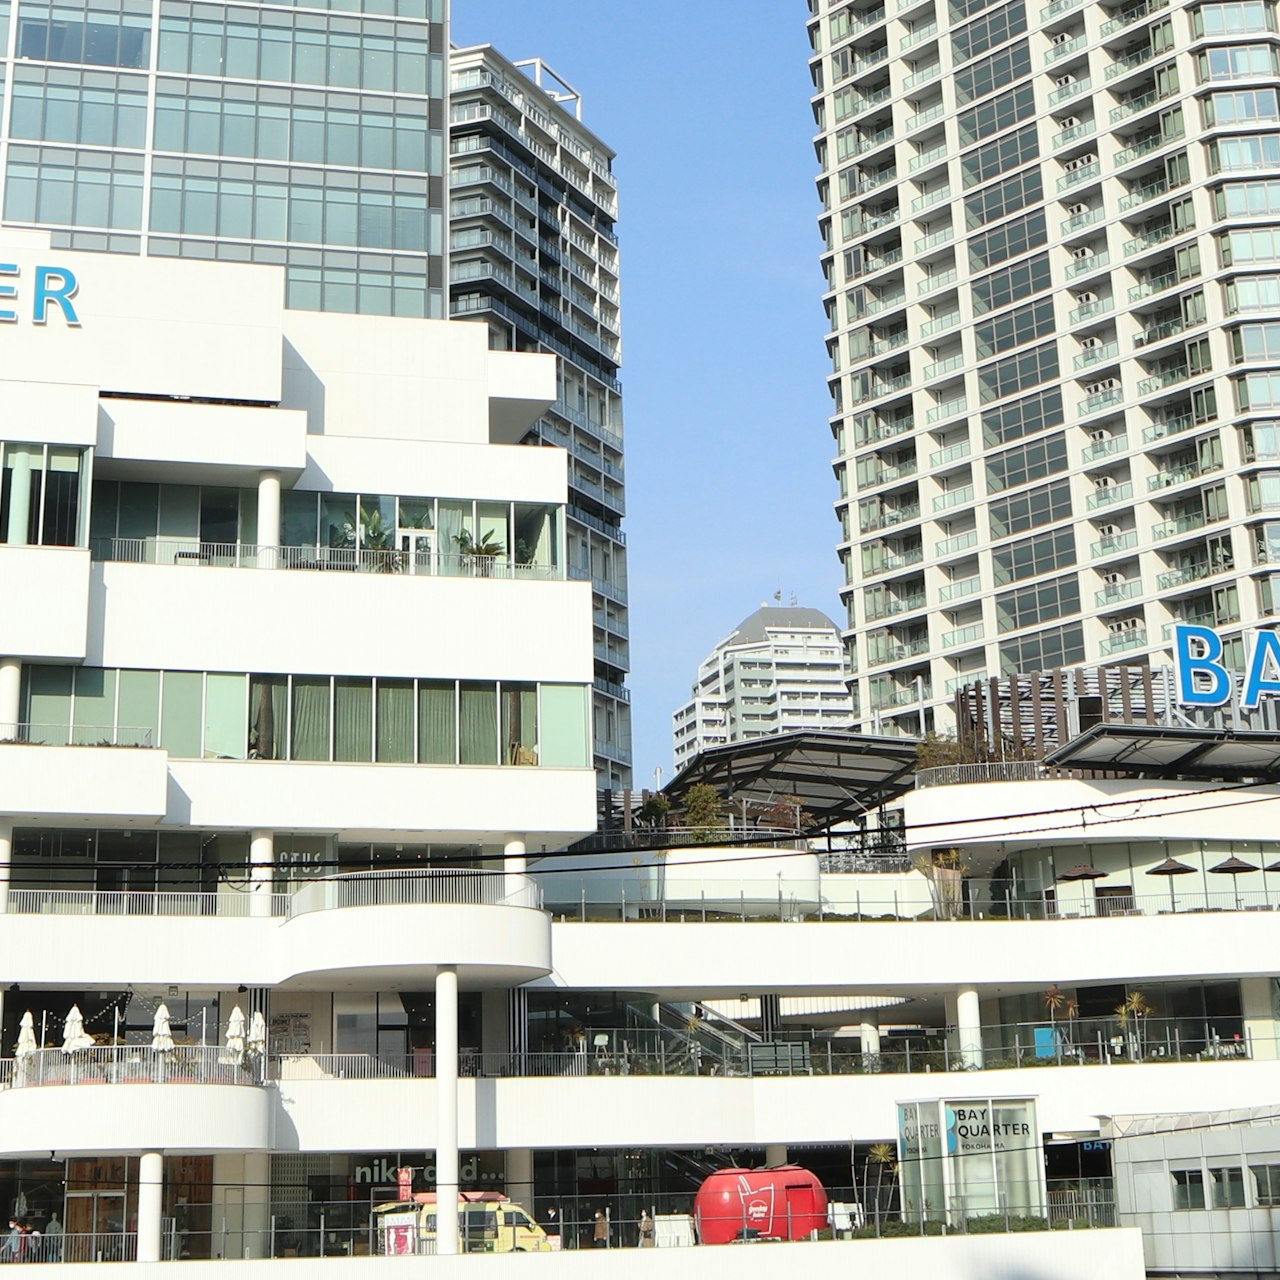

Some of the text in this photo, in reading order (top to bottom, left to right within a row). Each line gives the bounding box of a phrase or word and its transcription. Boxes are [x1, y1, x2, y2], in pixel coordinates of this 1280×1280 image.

[273, 851, 322, 874] CTUS
[957, 1109, 987, 1121] BAY
[958, 1123, 1030, 1139] QUARTER
[961, 1141, 1005, 1150] YOKOHAMA
